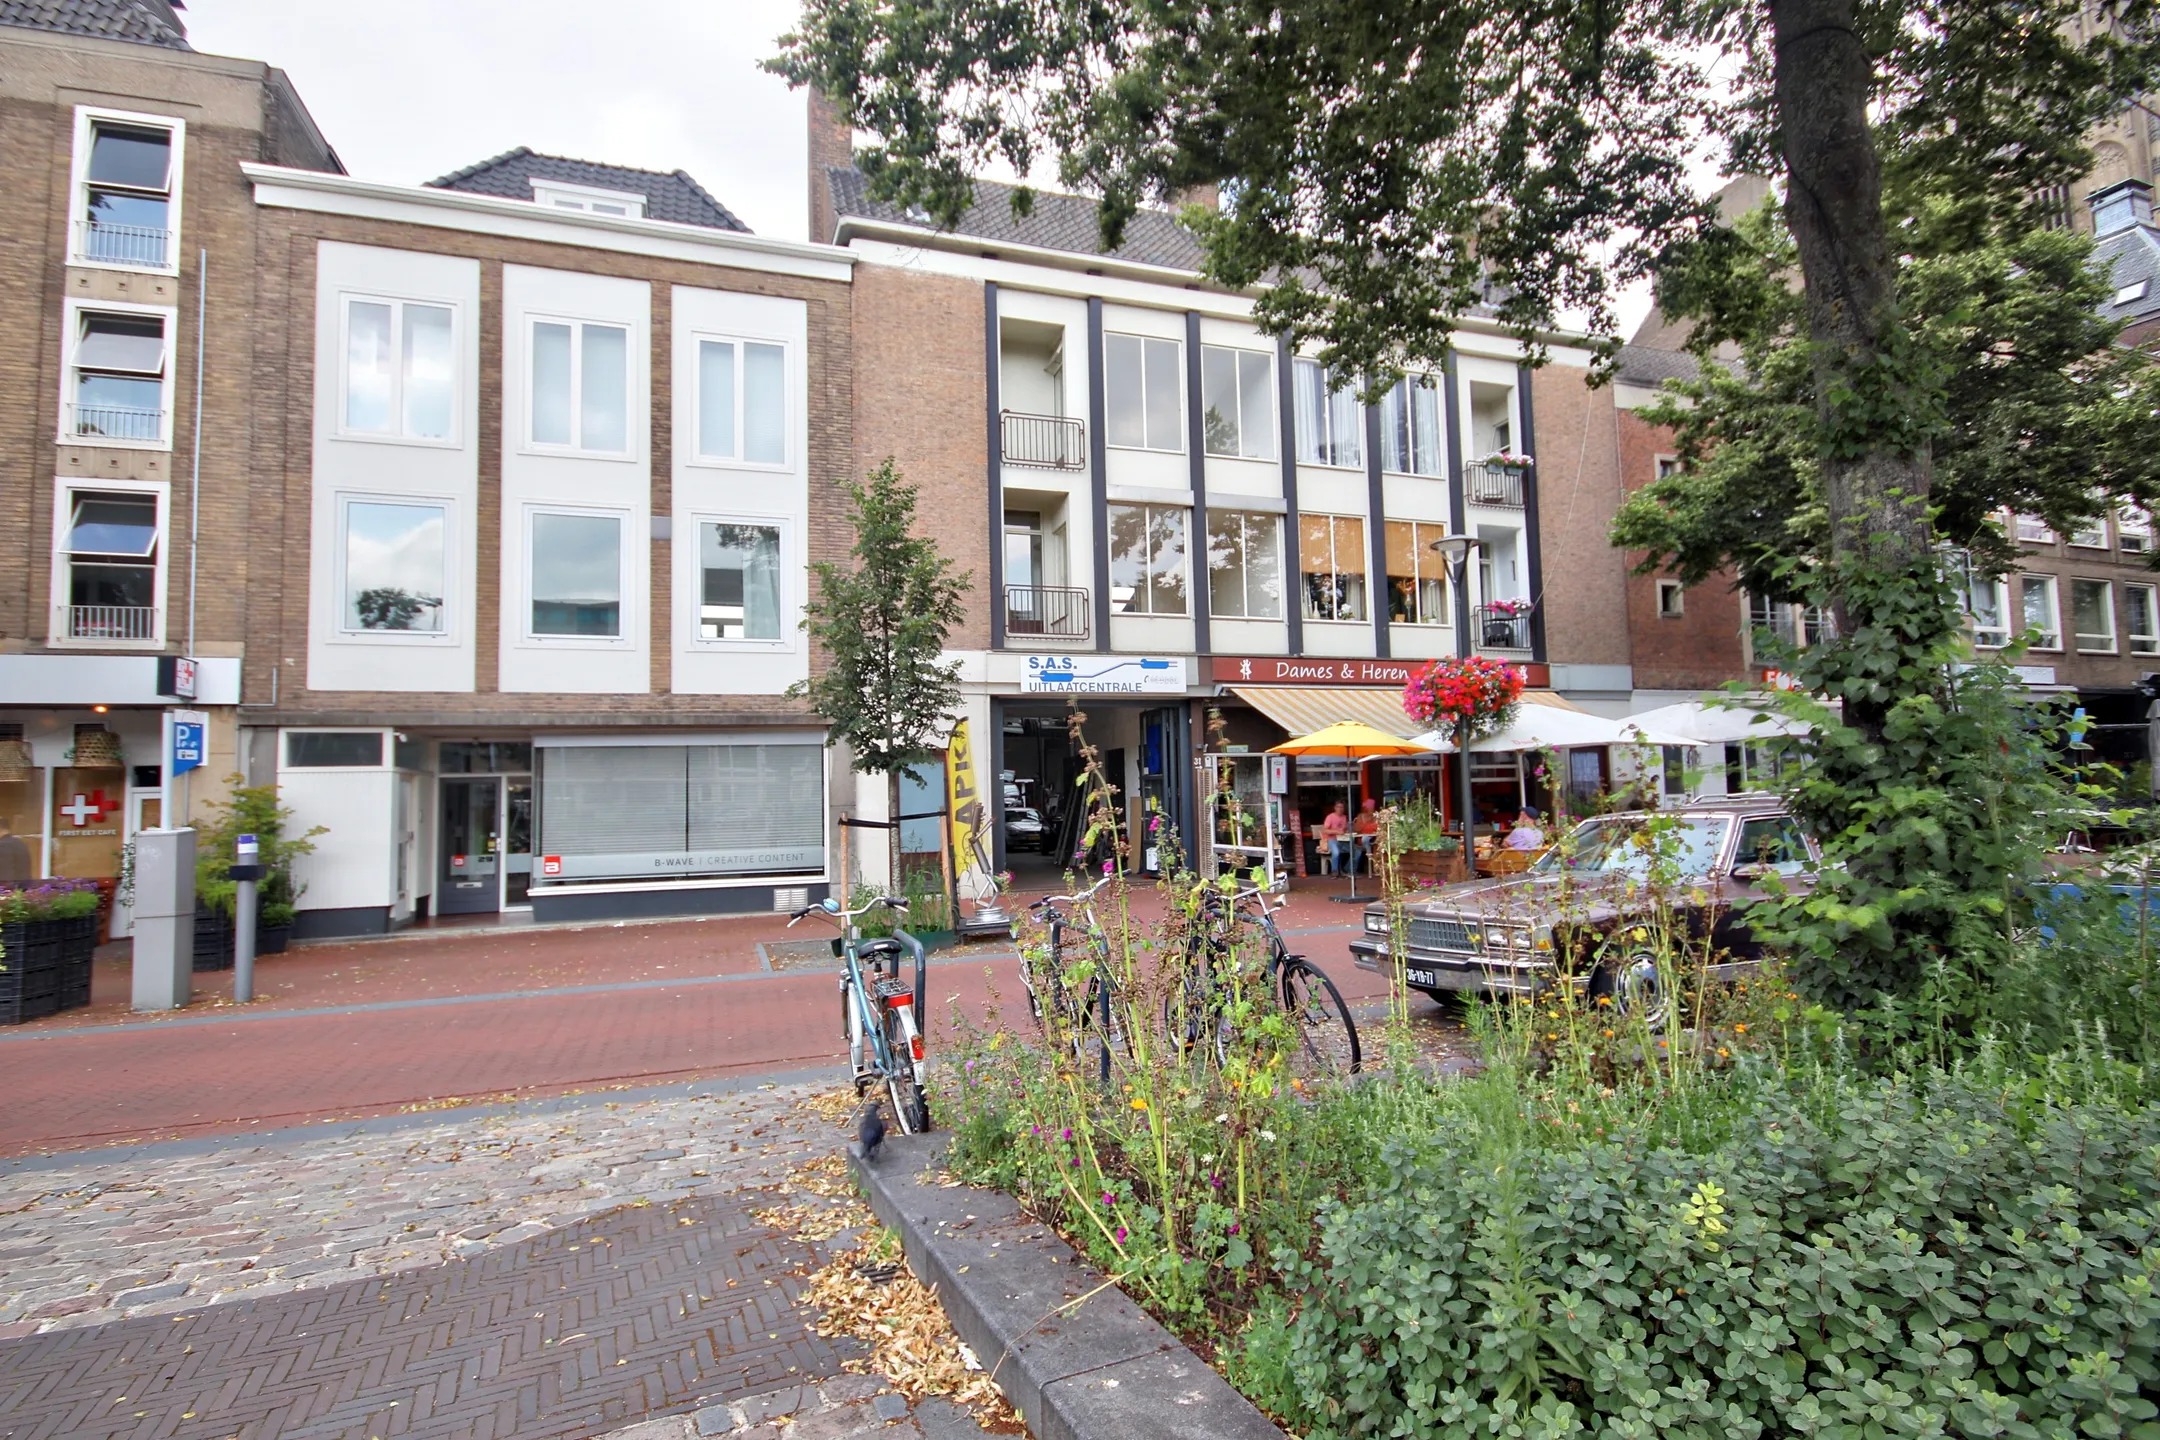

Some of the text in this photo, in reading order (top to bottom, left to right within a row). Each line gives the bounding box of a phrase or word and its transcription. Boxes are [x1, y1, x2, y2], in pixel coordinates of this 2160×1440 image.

[1029, 657, 1077, 669] S.A.S.
[1276, 662, 1409, 680] Dames & Heren
[1029, 682, 1143, 693] UITLAATCENTRALE
[176, 725, 190, 748] P
[1193, 757, 1202, 765] 31
[654, 853, 805, 867] B-WAVE CREATIVE CONTENT
